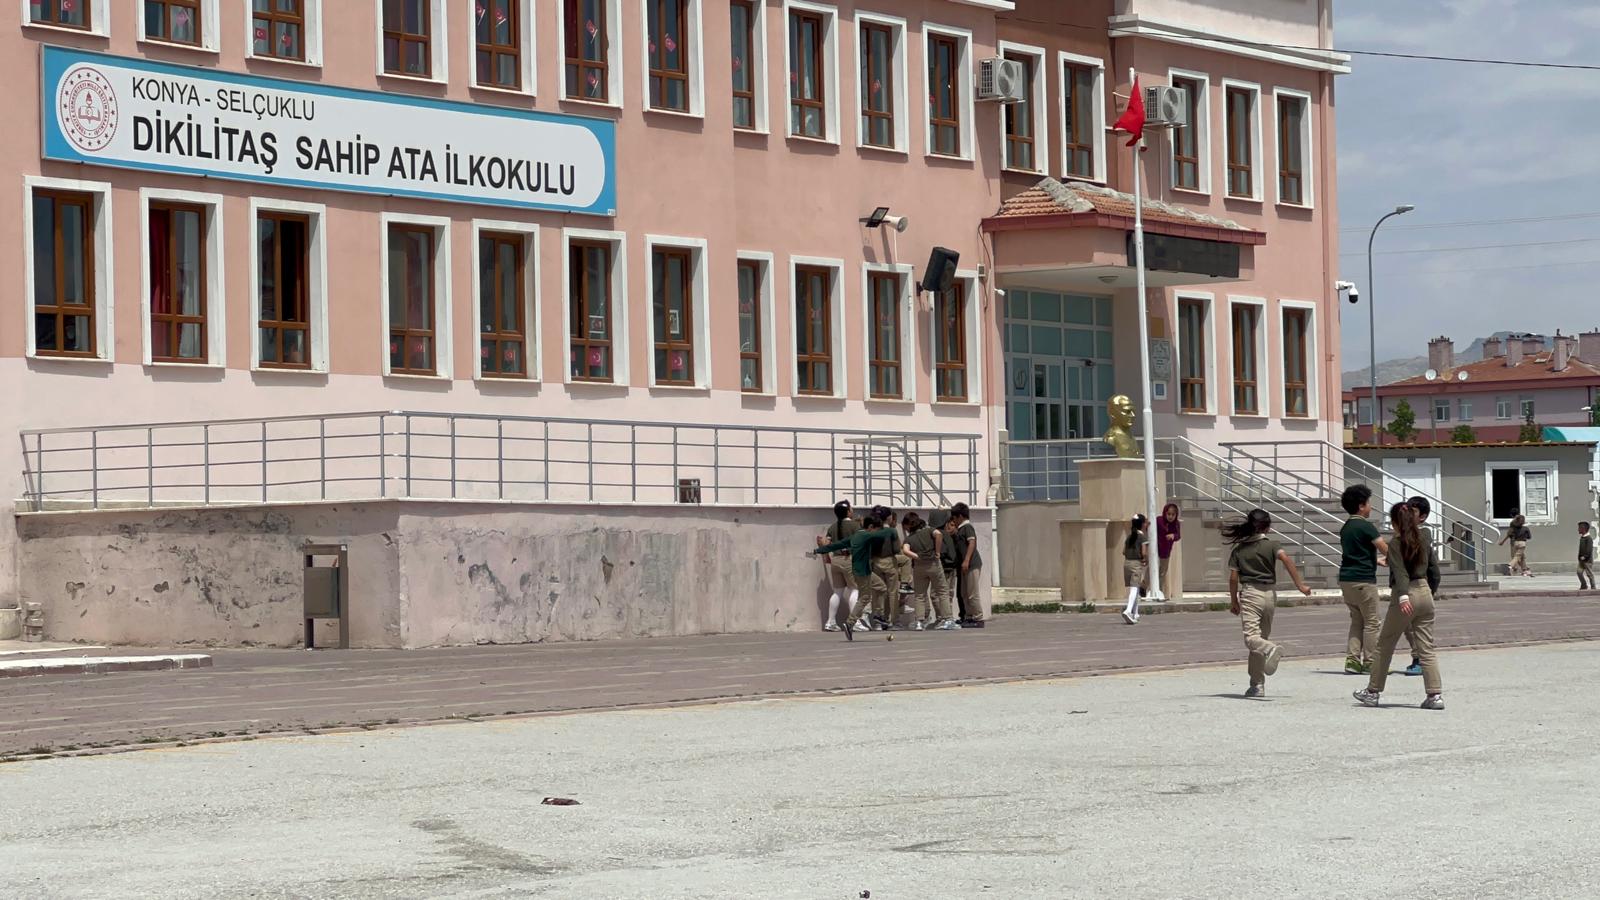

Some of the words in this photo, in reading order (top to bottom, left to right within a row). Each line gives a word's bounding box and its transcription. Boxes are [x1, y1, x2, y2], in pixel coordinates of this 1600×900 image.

[132, 76, 201, 107] KONYA
[216, 88, 315, 121] SELÇUKLU
[133, 109, 278, 175] DİKİLİTAŞ
[295, 133, 381, 176] SAHİP
[387, 146, 439, 183] ATA
[445, 143, 575, 195] İLKOKULU
